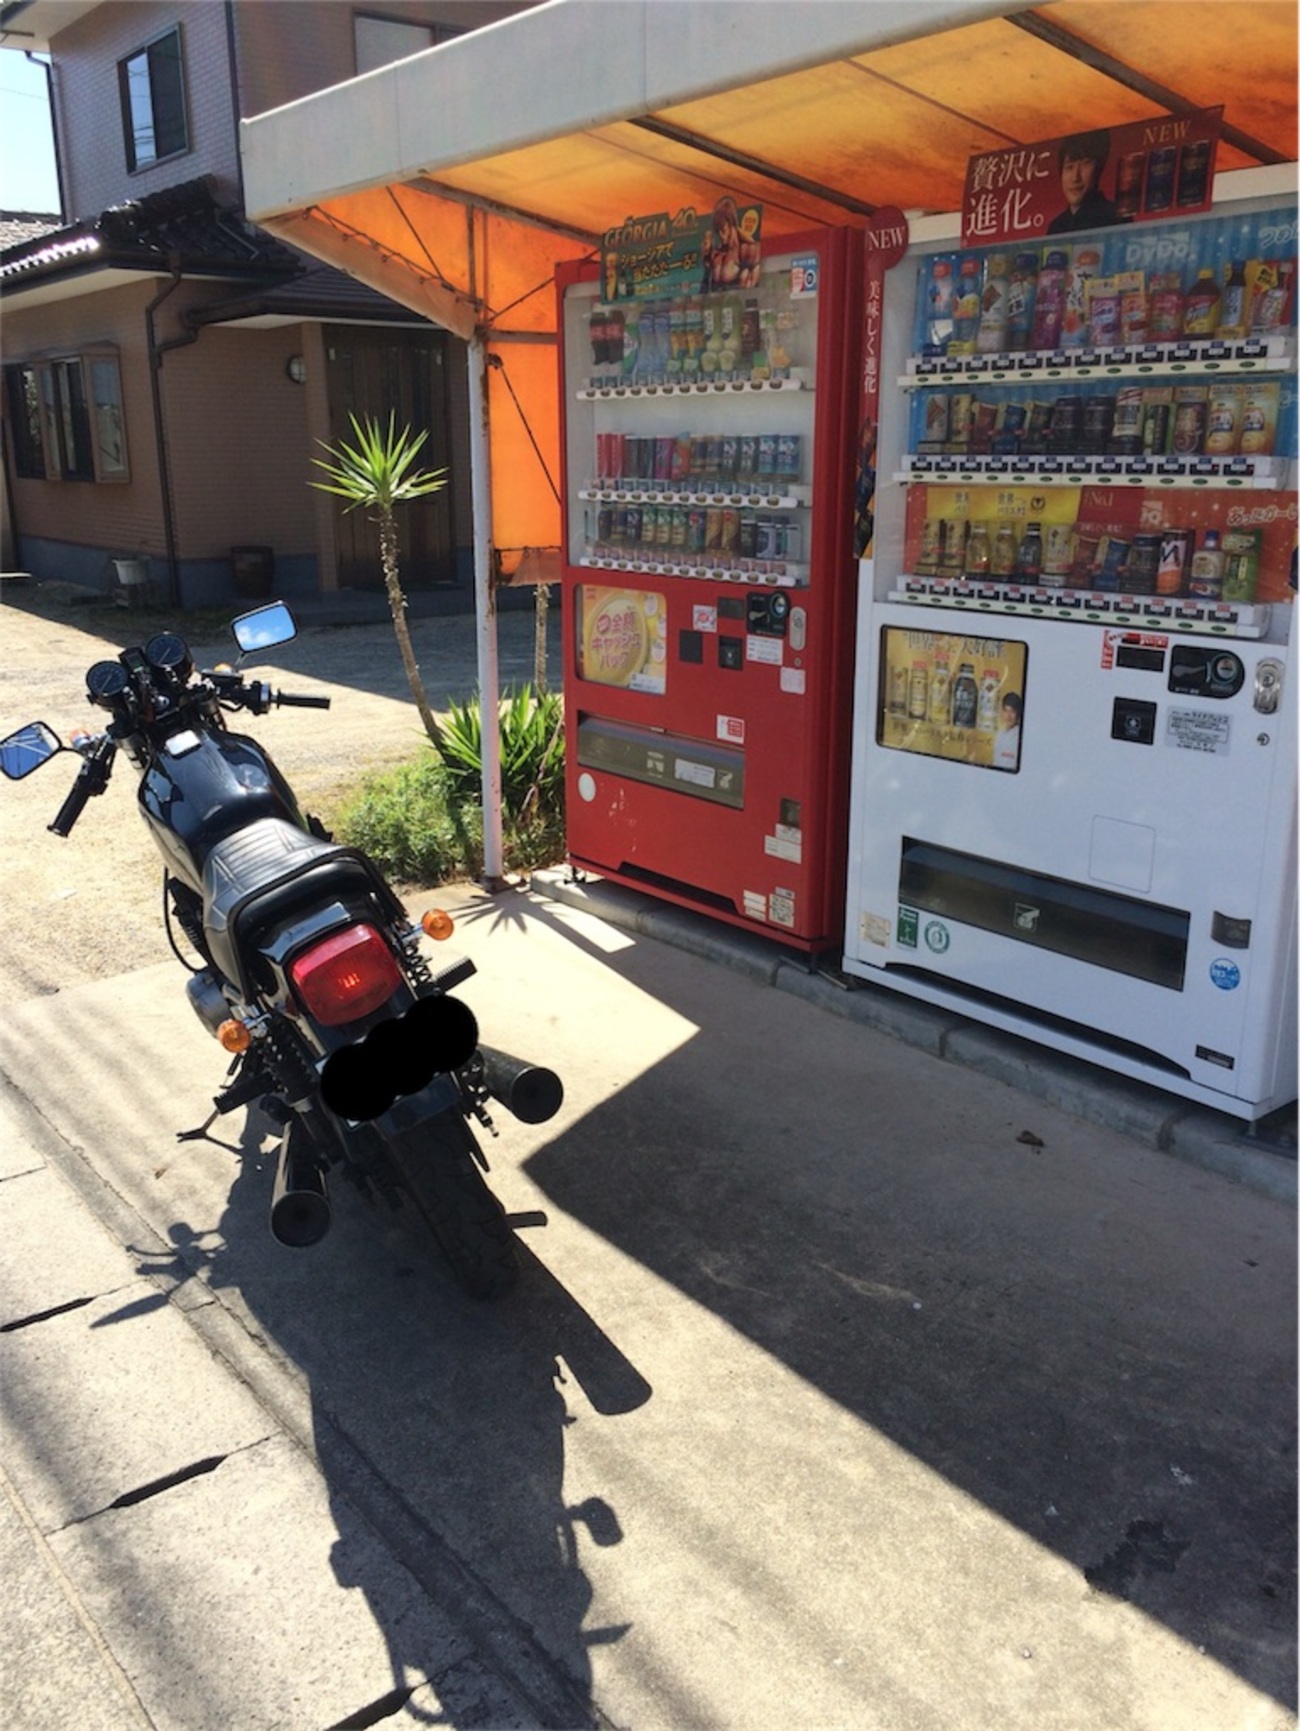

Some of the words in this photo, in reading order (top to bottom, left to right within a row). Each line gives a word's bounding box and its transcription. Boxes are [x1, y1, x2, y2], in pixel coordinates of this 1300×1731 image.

[1143, 120, 1191, 145] NEW
[971, 151, 1050, 193] 贅沢に
[604, 220, 667, 248] GEORGIA
[868, 227, 905, 250] NEW
